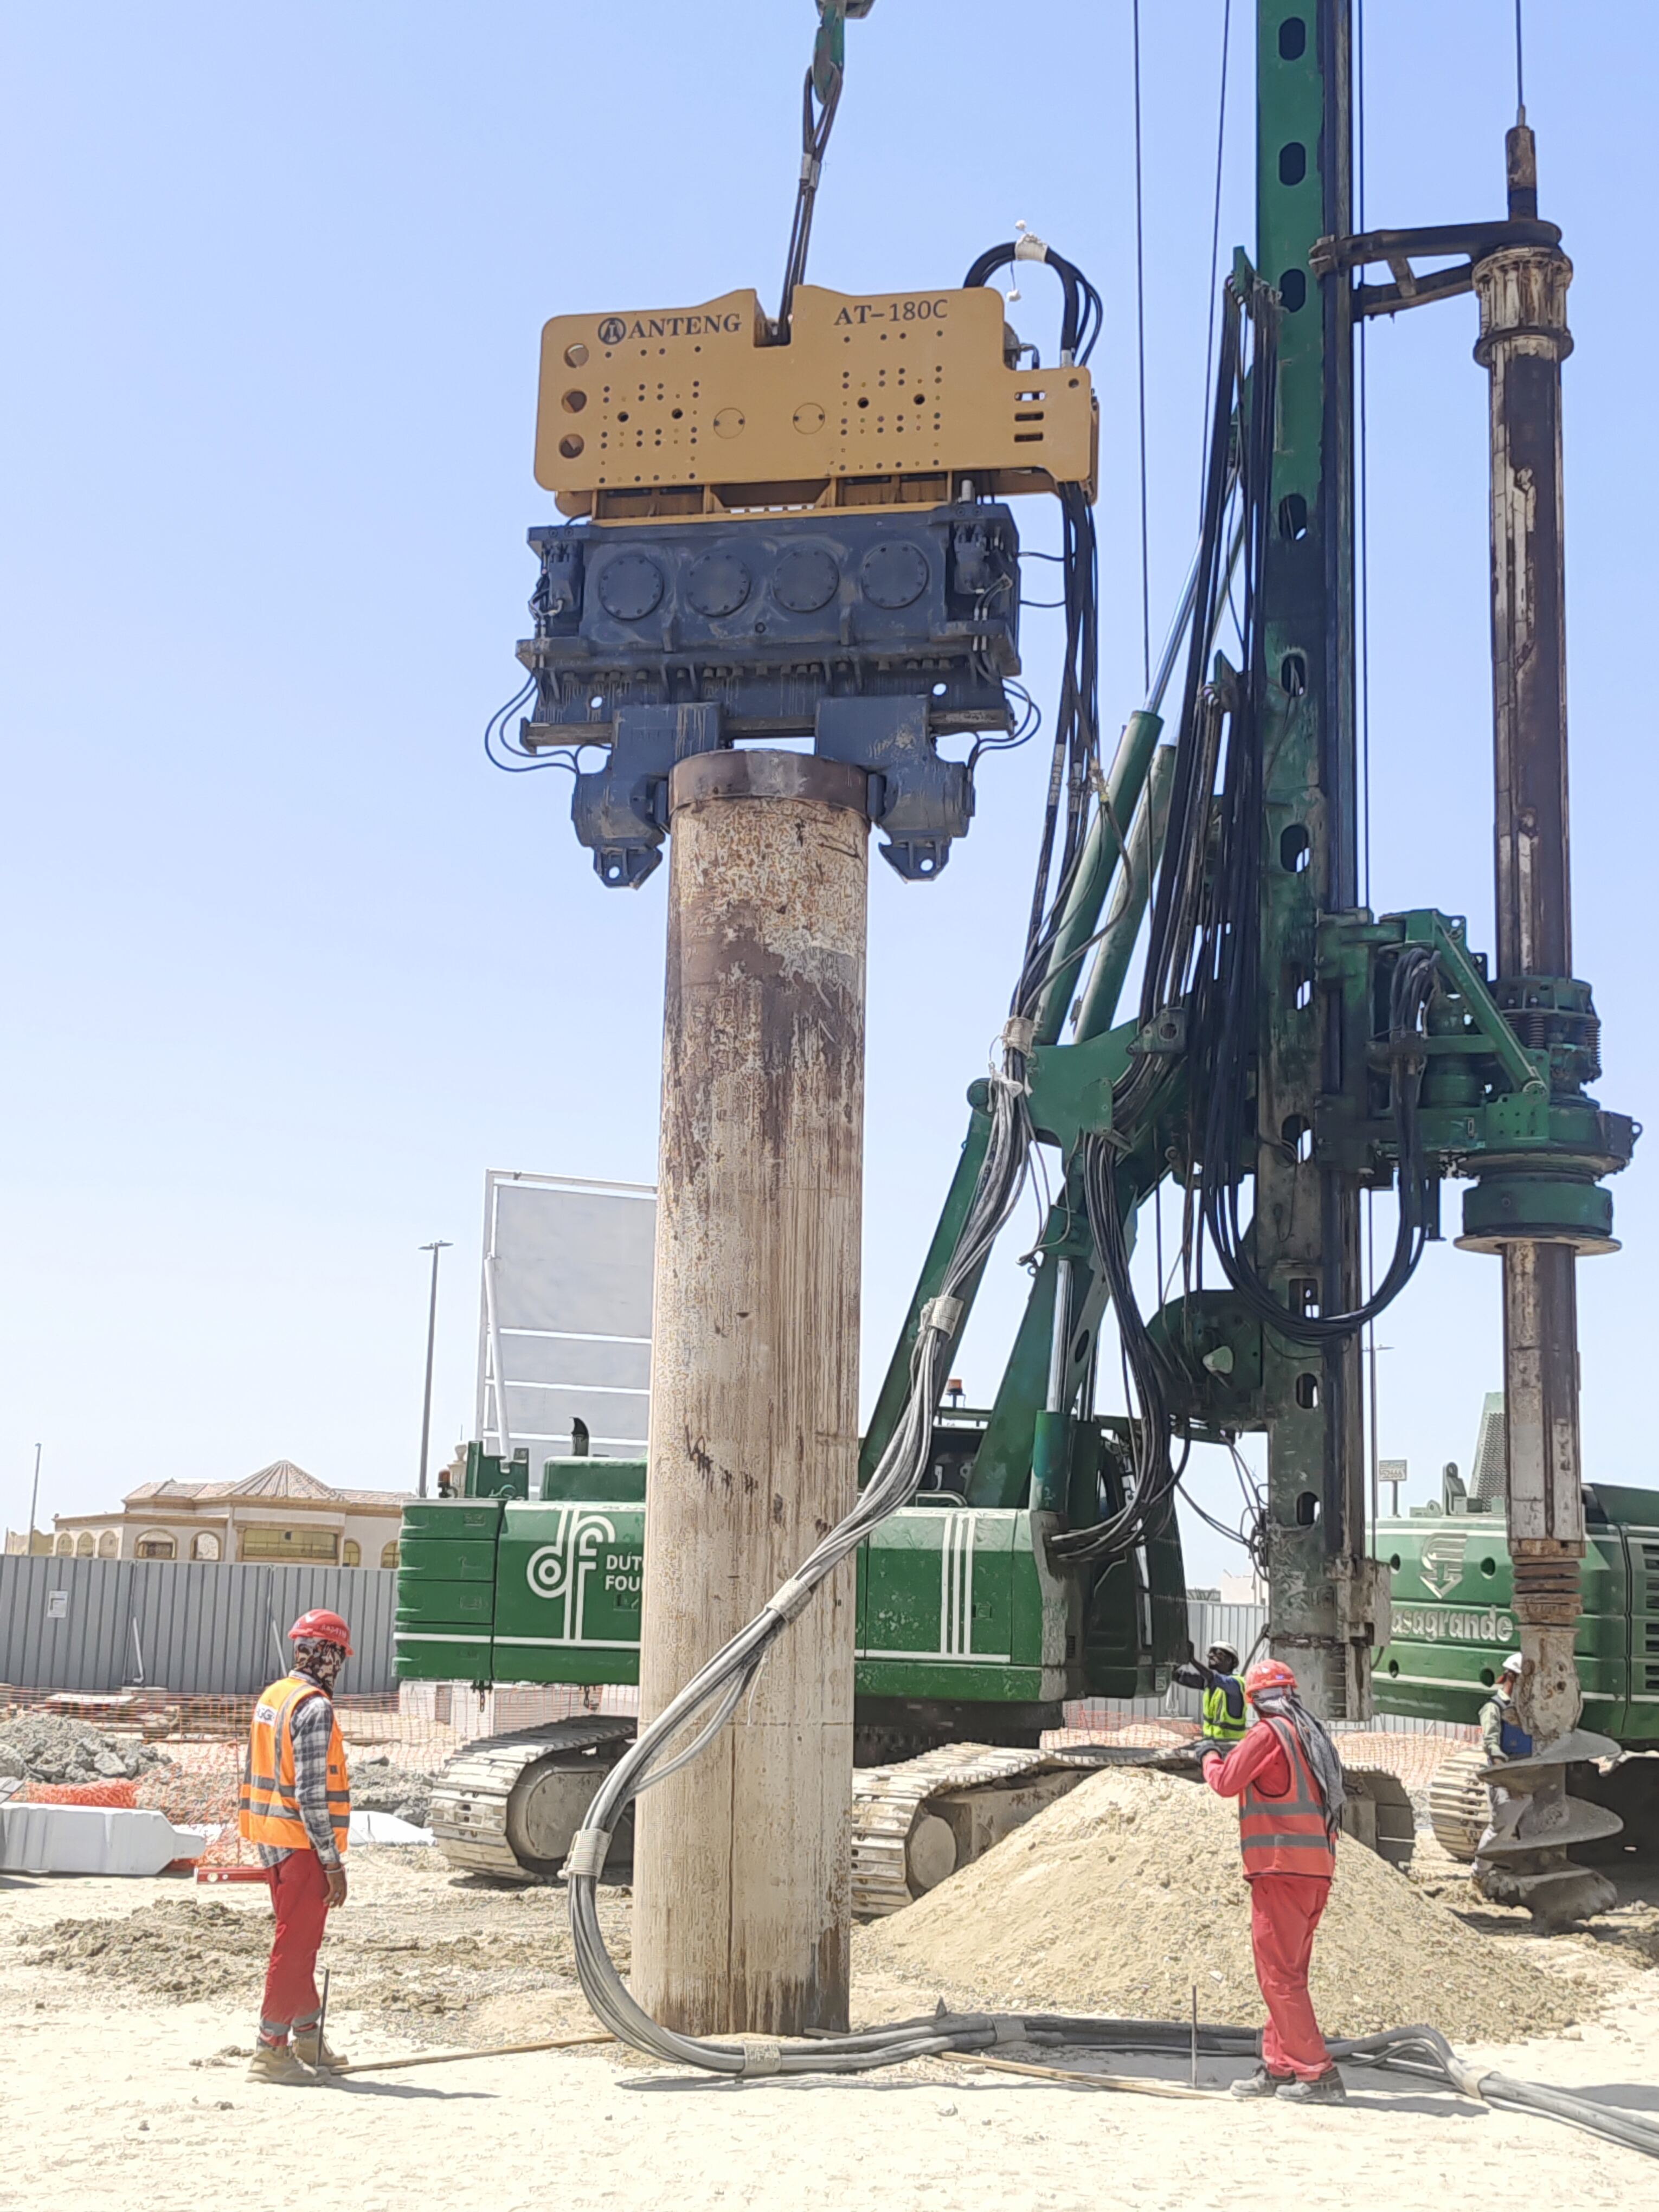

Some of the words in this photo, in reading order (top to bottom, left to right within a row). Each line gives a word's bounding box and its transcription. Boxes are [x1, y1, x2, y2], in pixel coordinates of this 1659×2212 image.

[833, 299, 948, 326] AT-180C
[627, 313, 742, 340] ANTENG
[606, 1553, 642, 1571] DUT
[605, 1575, 641, 1592] FOU
[1391, 1604, 1514, 1642] asagrande
